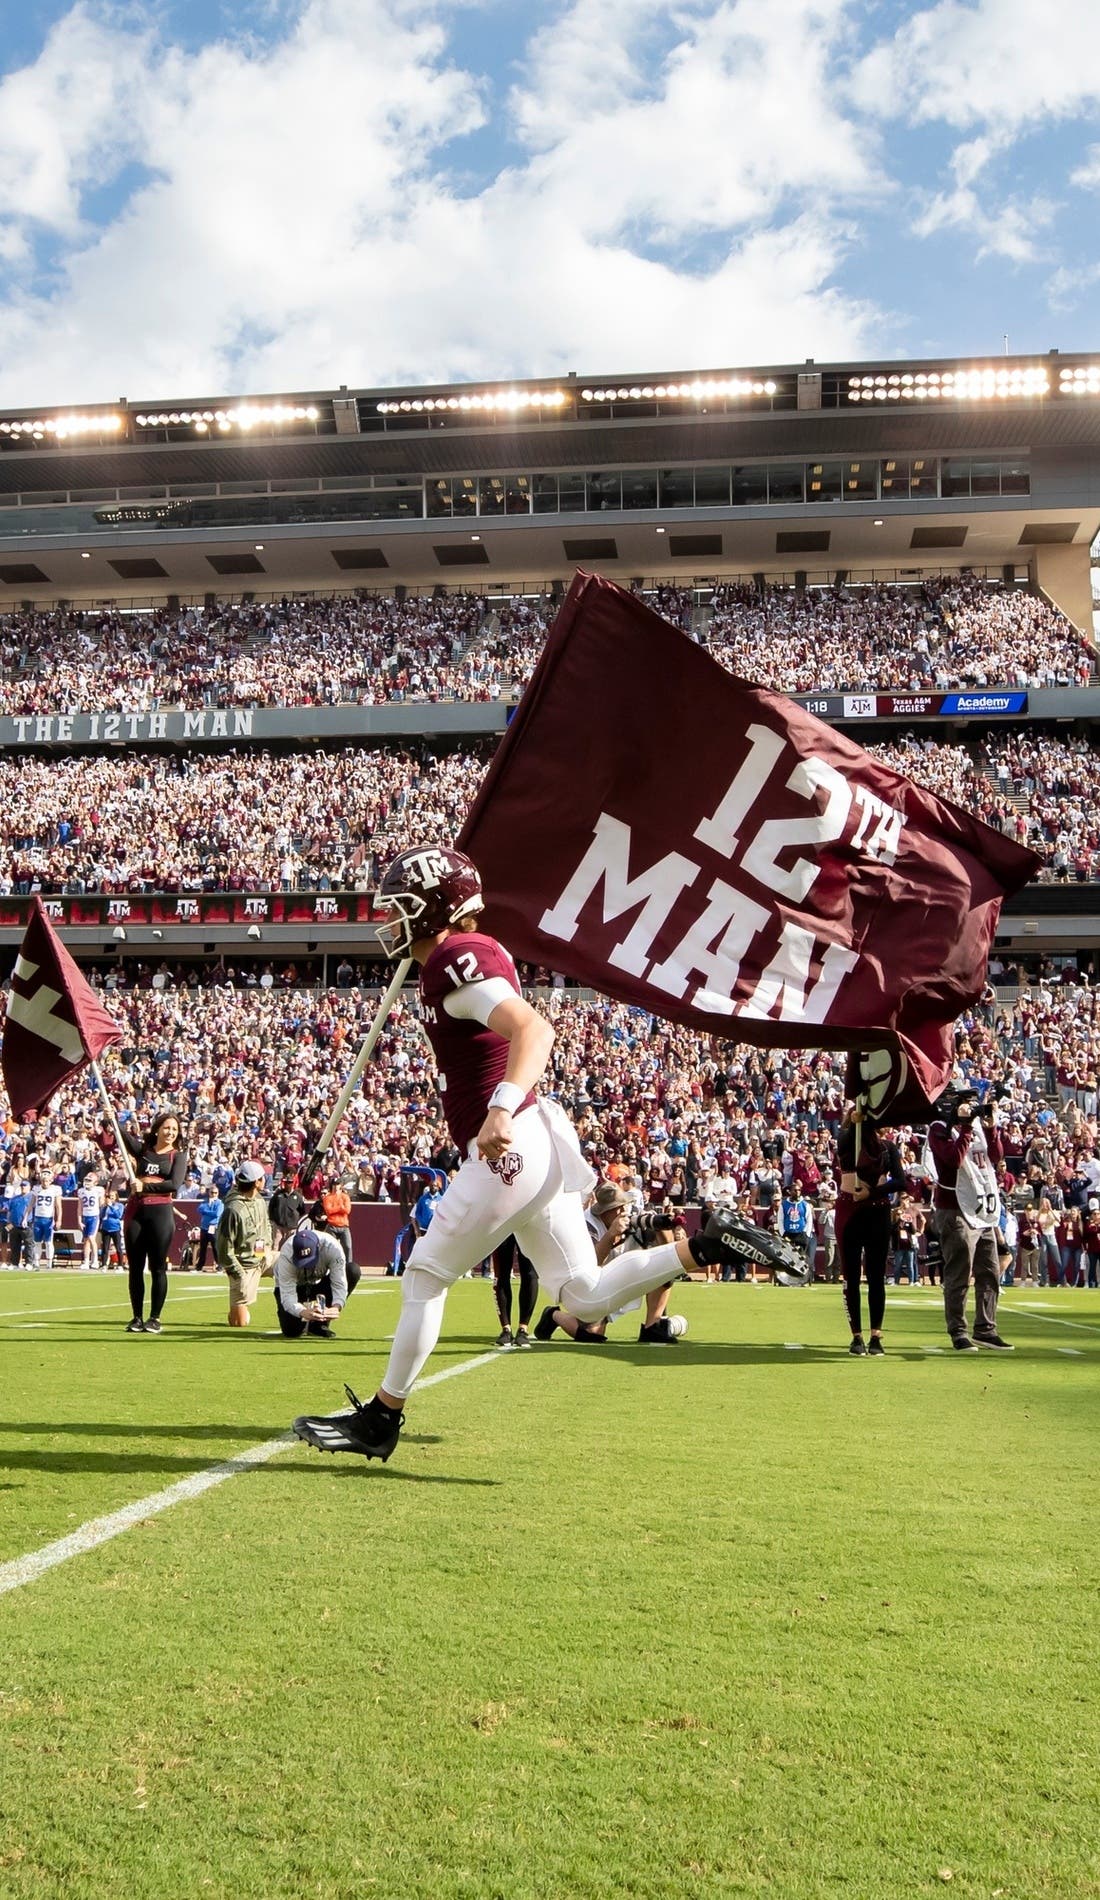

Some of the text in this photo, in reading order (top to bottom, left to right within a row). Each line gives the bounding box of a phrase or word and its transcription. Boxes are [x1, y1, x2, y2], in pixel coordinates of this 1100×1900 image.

[805, 701, 828, 713] 1:18
[893, 704, 925, 713] AGGIES
[957, 696, 1010, 709] Academy
[13, 710, 253, 742] THE 12TH MAN
[44, 901, 64, 917] TM
[538, 812, 860, 1024] MAN
[444, 951, 485, 988] 12
[37, 1196, 53, 1207] 29
[82, 1196, 96, 1207] 26
[720, 1232, 774, 1266] ADIZERO
